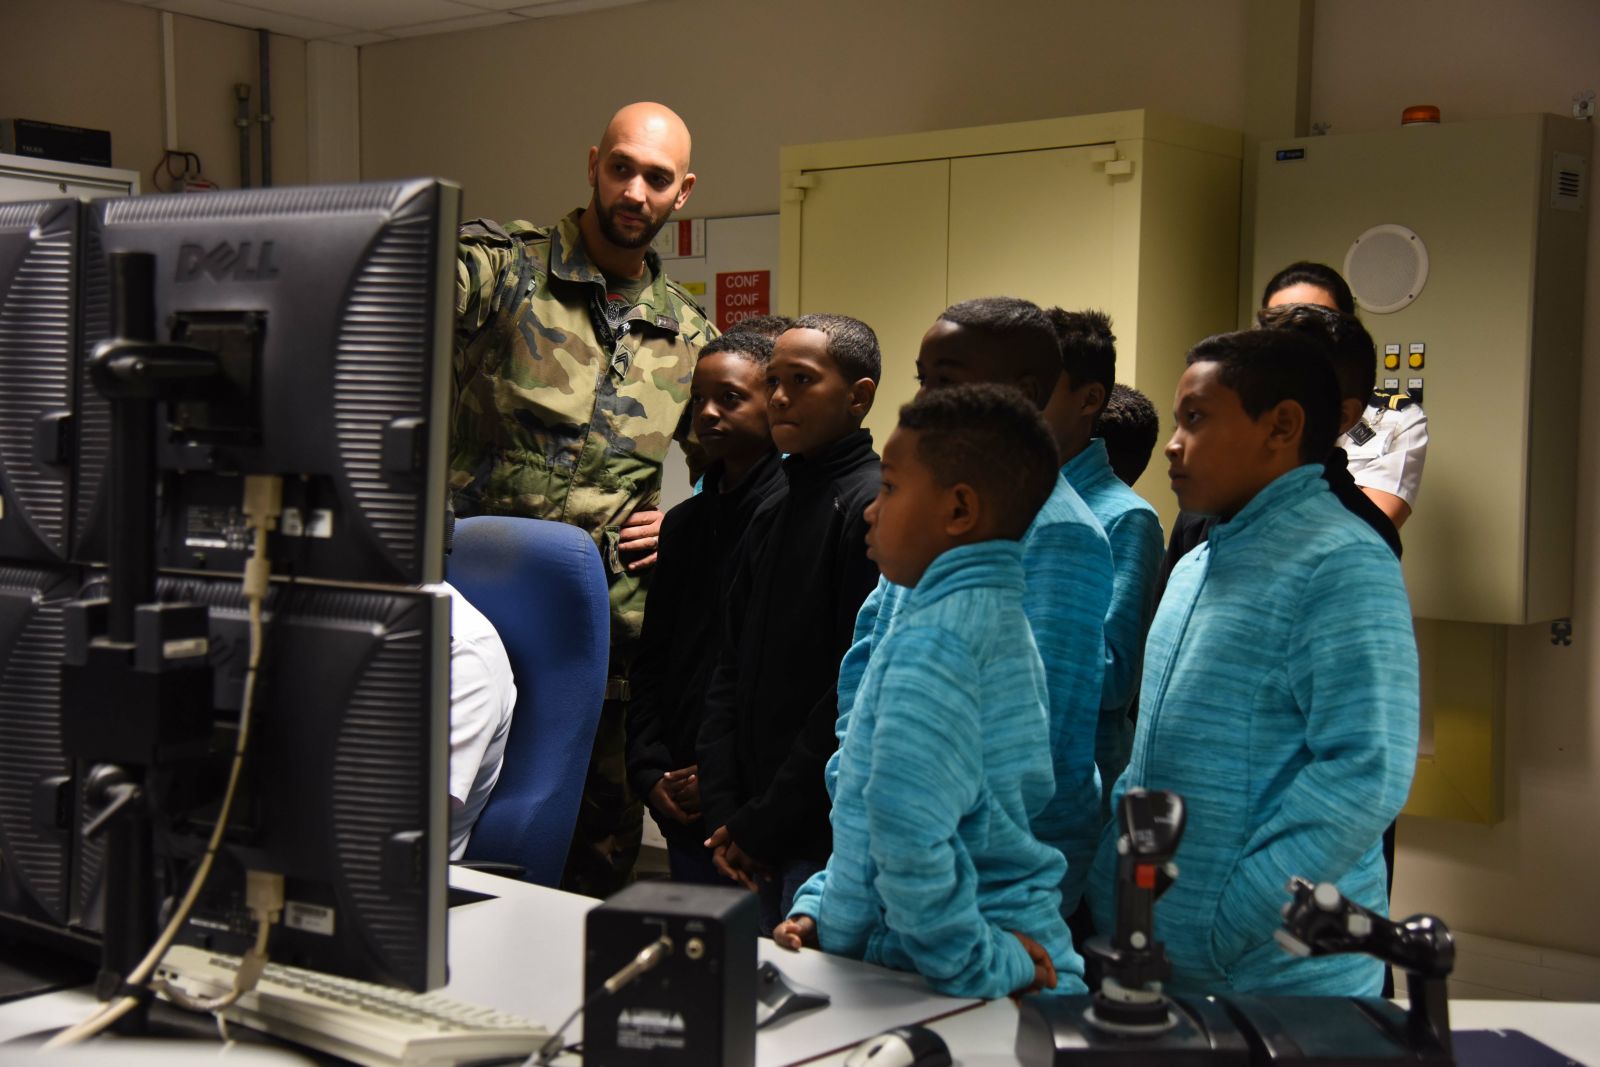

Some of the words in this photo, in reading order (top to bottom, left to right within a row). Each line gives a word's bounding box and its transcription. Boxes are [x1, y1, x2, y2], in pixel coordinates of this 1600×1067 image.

[175, 240, 279, 283] DELL
[726, 274, 759, 288] CONF
[725, 293, 759, 307] CONF
